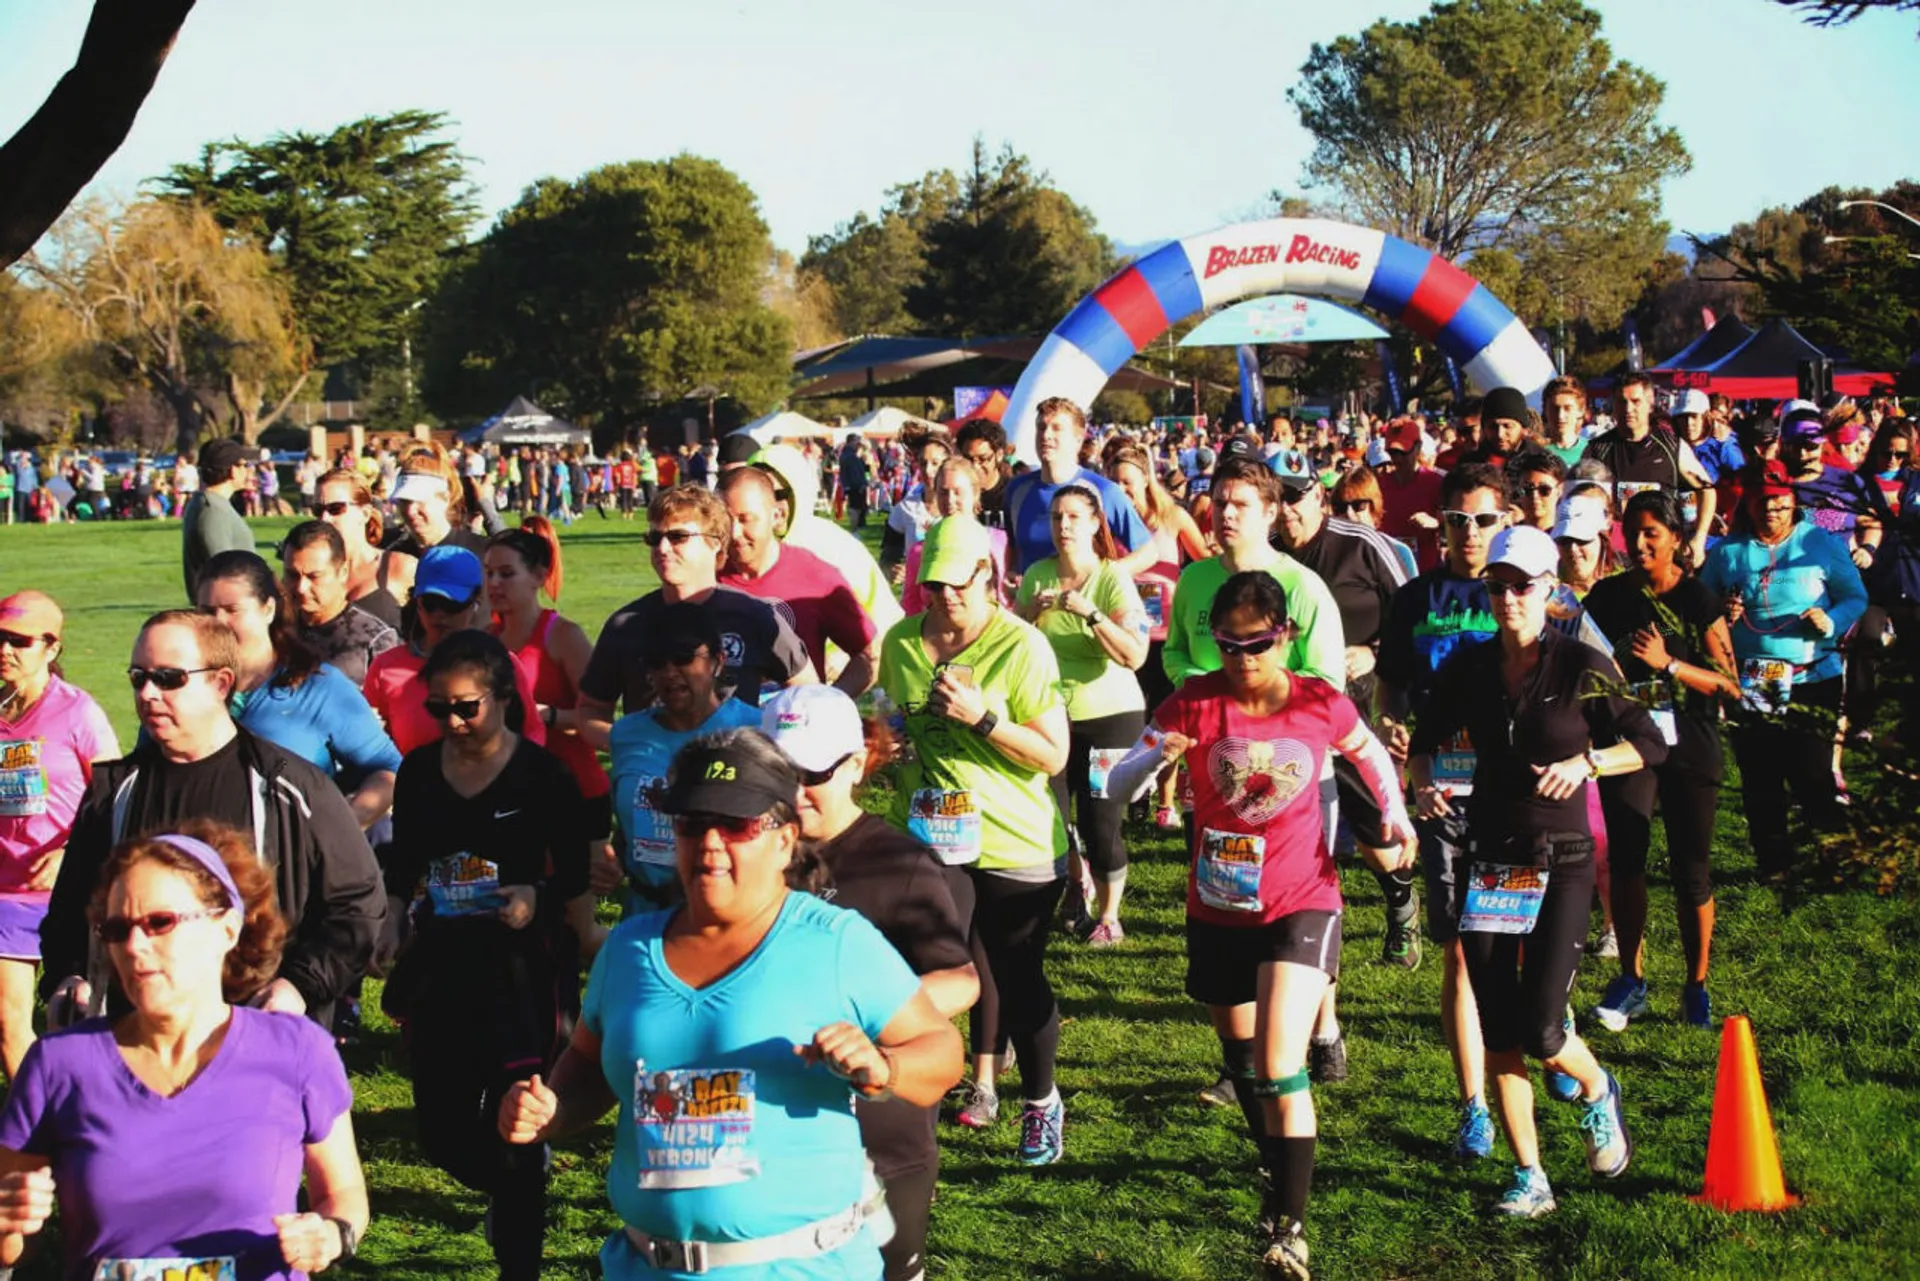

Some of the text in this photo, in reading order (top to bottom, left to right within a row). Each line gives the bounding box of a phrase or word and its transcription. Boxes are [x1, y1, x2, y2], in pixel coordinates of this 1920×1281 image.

[1204, 244, 1280, 279] BRAZEN
[1477, 895, 1520, 911] 4264
[691, 1070, 744, 1101] BAY
[663, 1123, 714, 1146] 4124
[647, 1146, 742, 1168] VERONI
